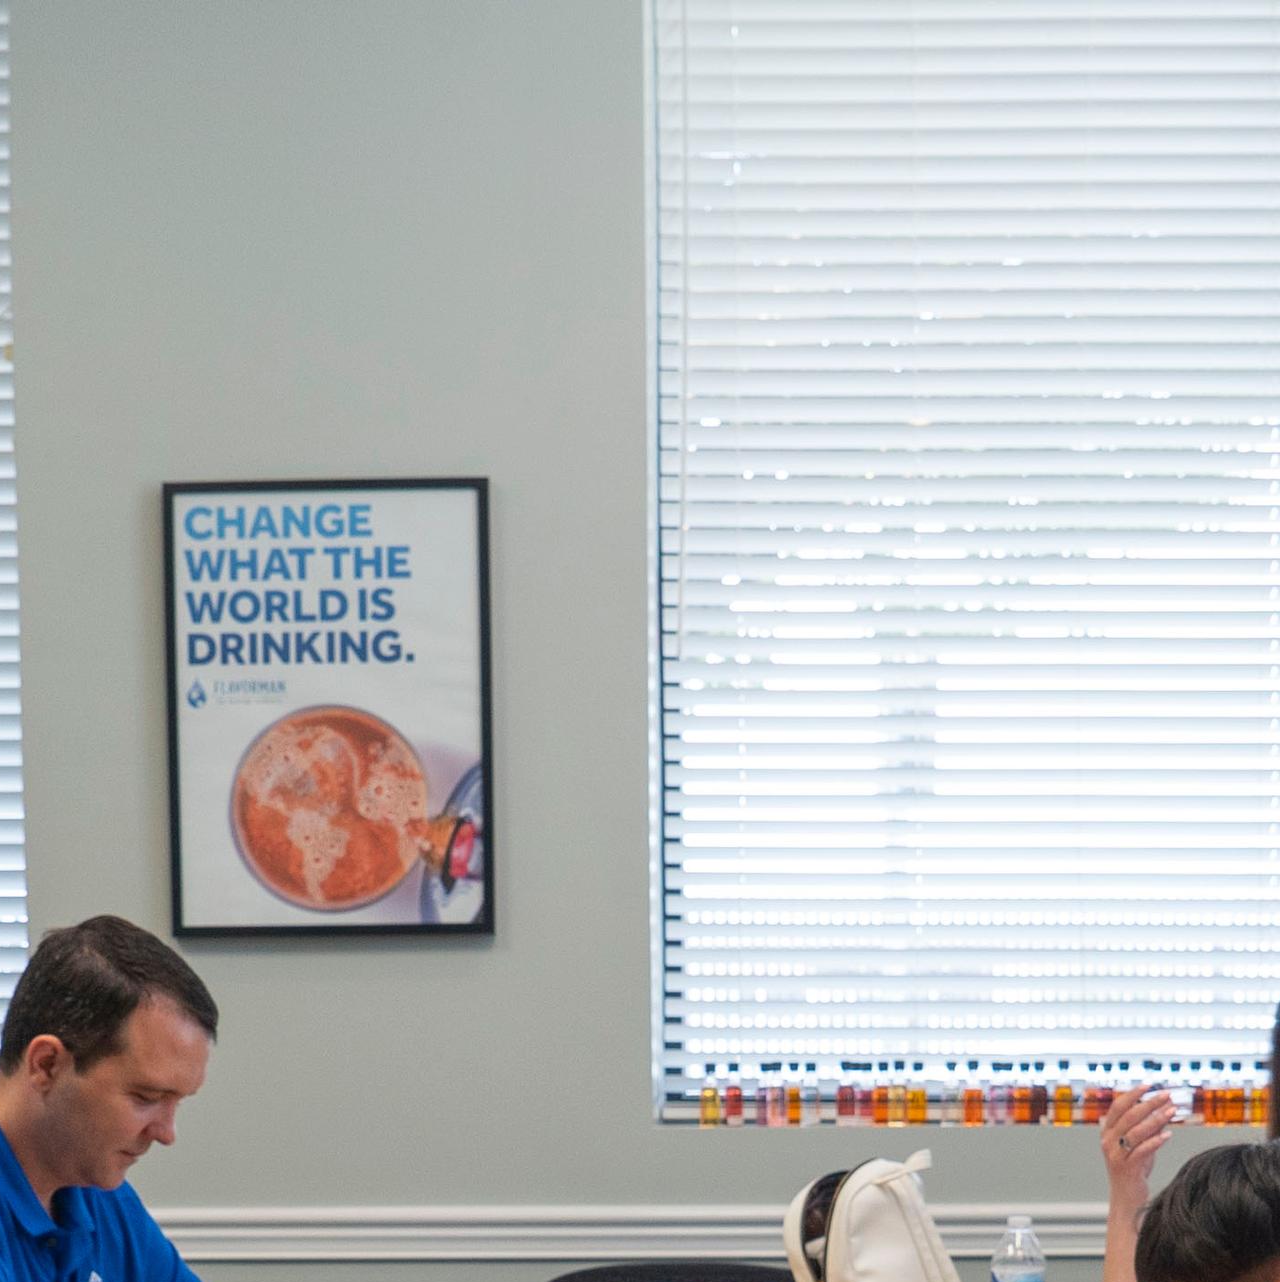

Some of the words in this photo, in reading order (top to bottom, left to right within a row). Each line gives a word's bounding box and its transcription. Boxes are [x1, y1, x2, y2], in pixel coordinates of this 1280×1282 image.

[184, 504, 373, 541] CHANGE
[184, 547, 315, 582] WHAT
[323, 546, 412, 579] THE
[185, 588, 349, 624] WORLD
[358, 587, 396, 621] IS
[187, 629, 416, 666] DRINKING.
